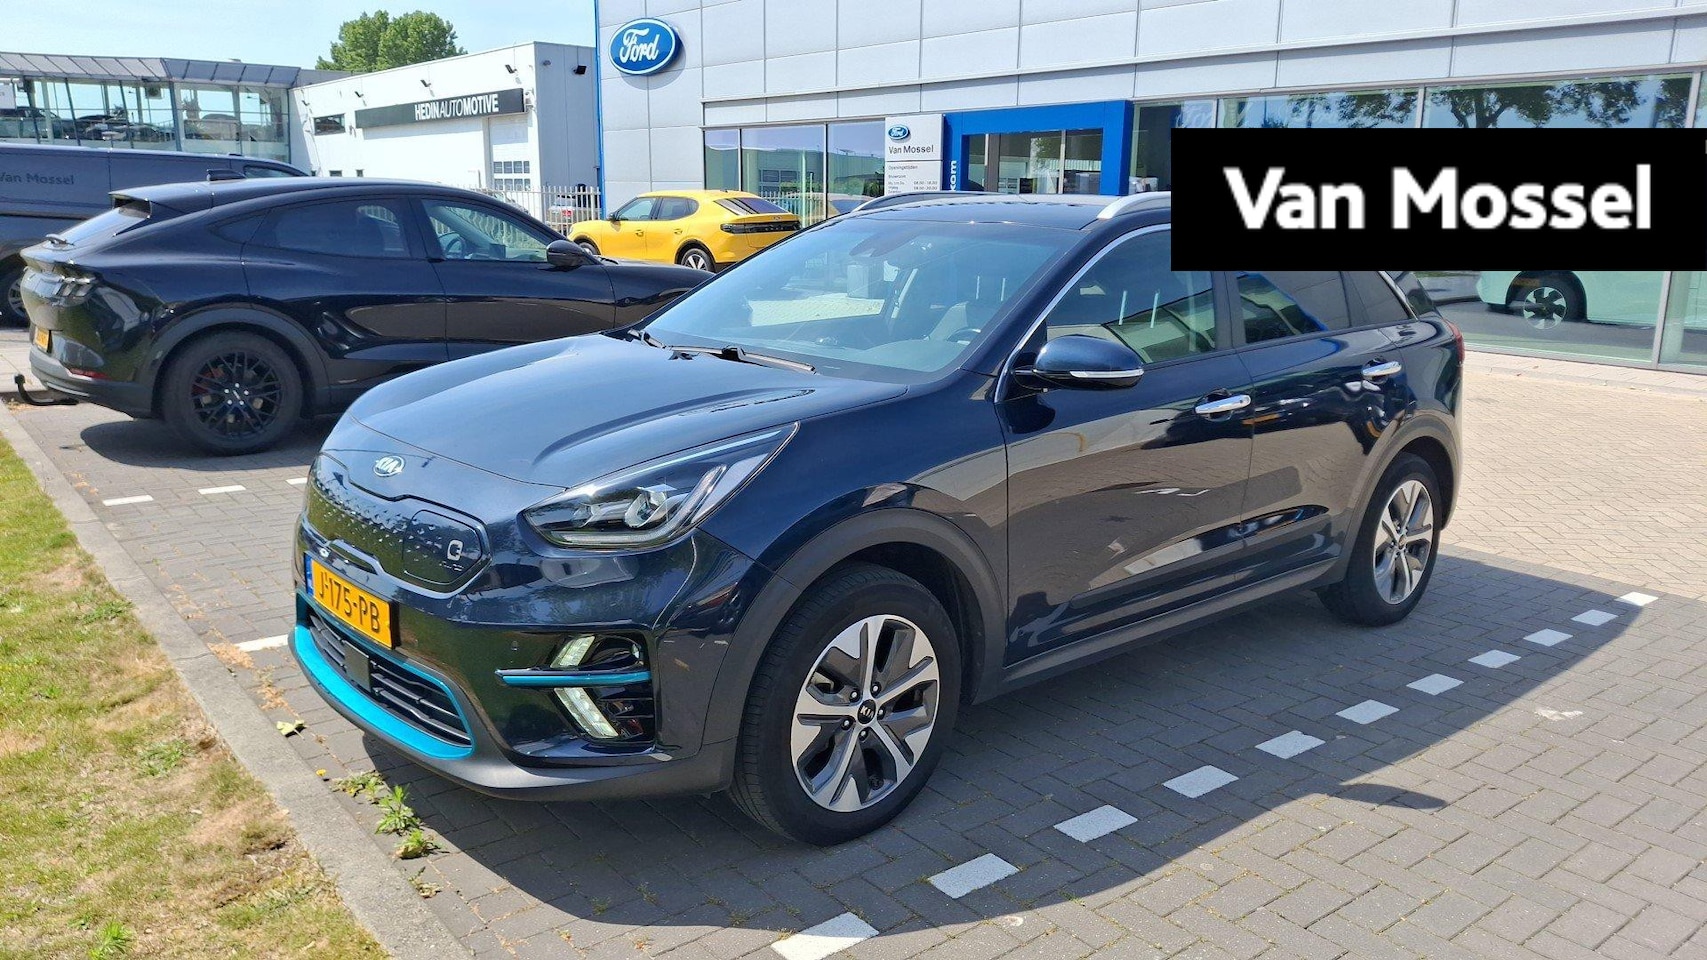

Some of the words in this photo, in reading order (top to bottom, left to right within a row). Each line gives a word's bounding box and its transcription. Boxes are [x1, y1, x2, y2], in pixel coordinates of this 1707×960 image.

[619, 28, 661, 63] Ford
[889, 146, 902, 154] Van
[903, 144, 934, 154] Mossel
[26, 172, 75, 185] Mossel
[860, 705, 874, 718] KIA
